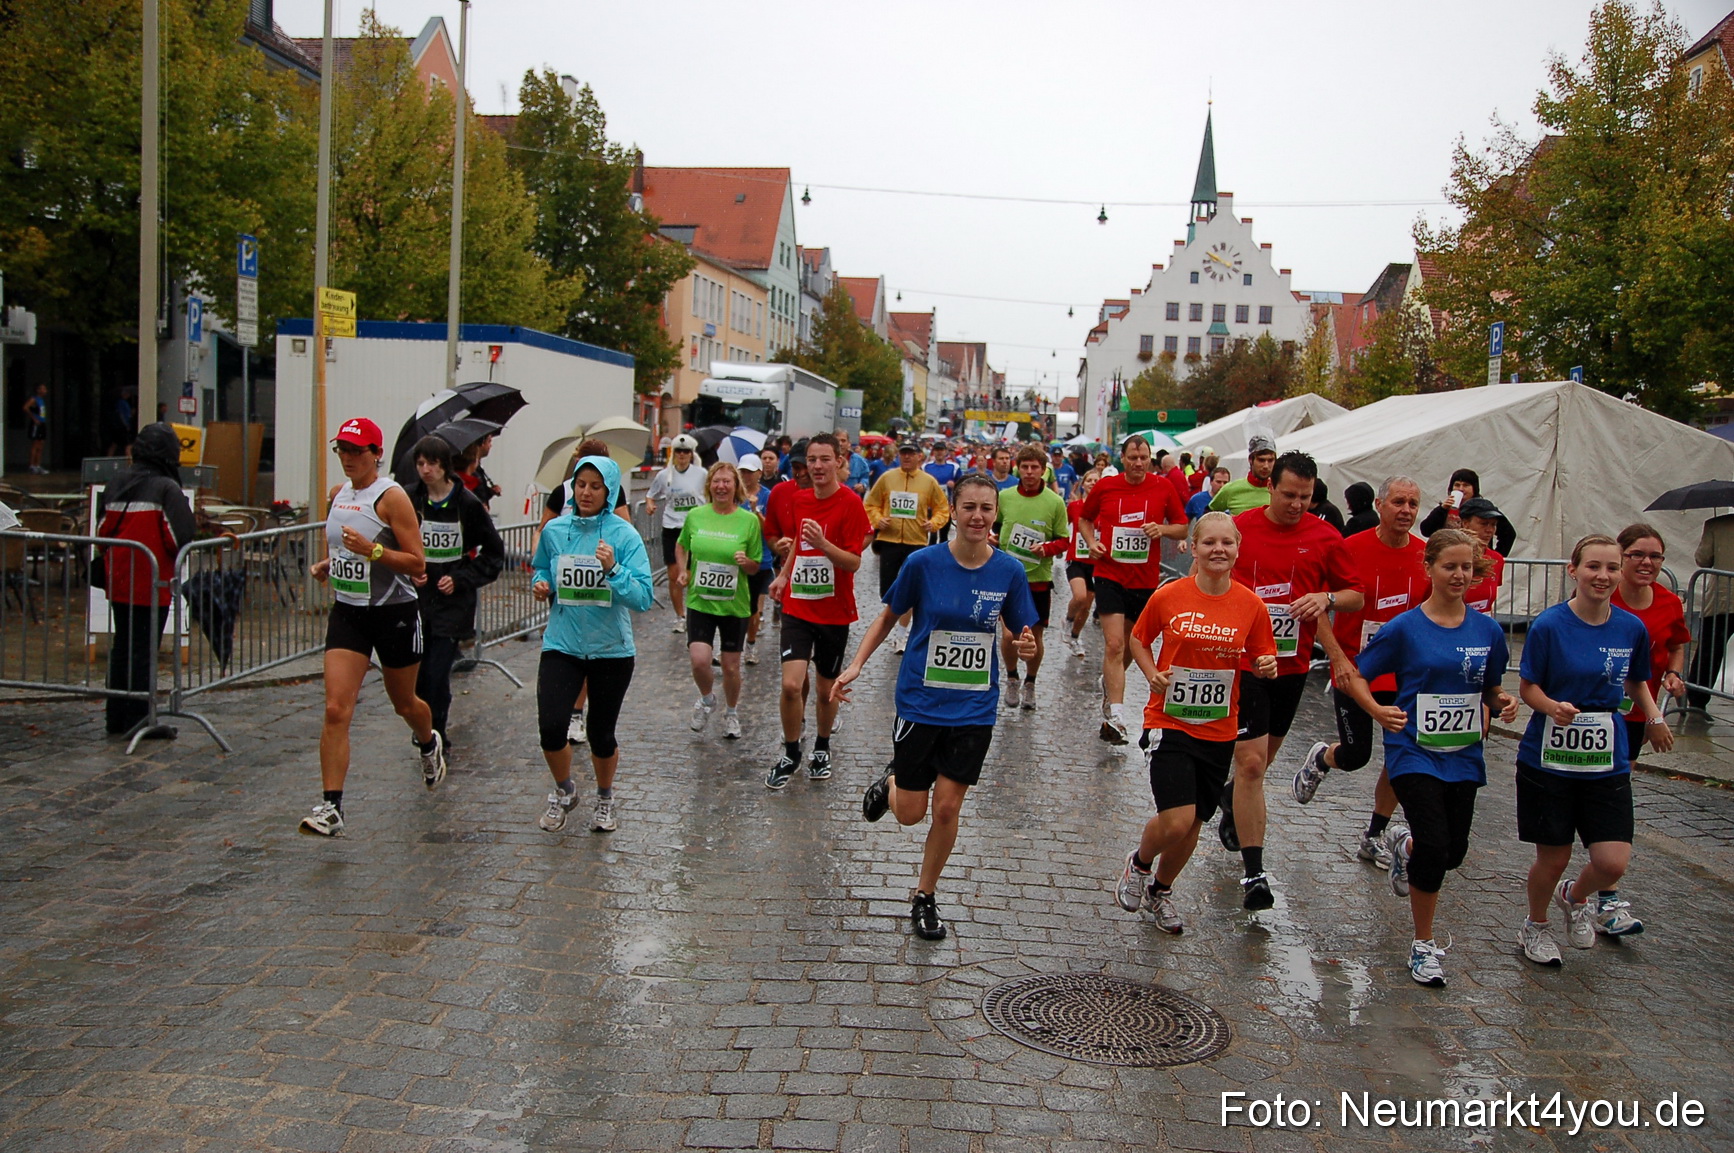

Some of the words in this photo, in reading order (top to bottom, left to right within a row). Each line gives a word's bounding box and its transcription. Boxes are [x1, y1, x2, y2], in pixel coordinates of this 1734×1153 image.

[190, 302, 200, 336] P
[1492, 327, 1501, 352] P
[674, 496, 696, 507] 5210
[891, 498, 915, 509] 5102
[423, 532, 459, 548] 5037
[1116, 536, 1147, 550] 5135
[331, 558, 364, 580] 5069
[562, 568, 607, 588] 5002
[794, 567, 829, 584] 5138
[699, 571, 734, 588] 5202
[1180, 616, 1238, 636] Fischer
[1272, 618, 1295, 638] 22
[1184, 632, 1234, 643] AUTOMOBILE
[934, 645, 987, 669] 5209
[1172, 681, 1226, 705] 5188
[1181, 707, 1211, 717] Sandra
[1424, 708, 1475, 732] 5227
[1550, 726, 1608, 751] 5063
[1543, 751, 1611, 764] Gabriela-Marie
